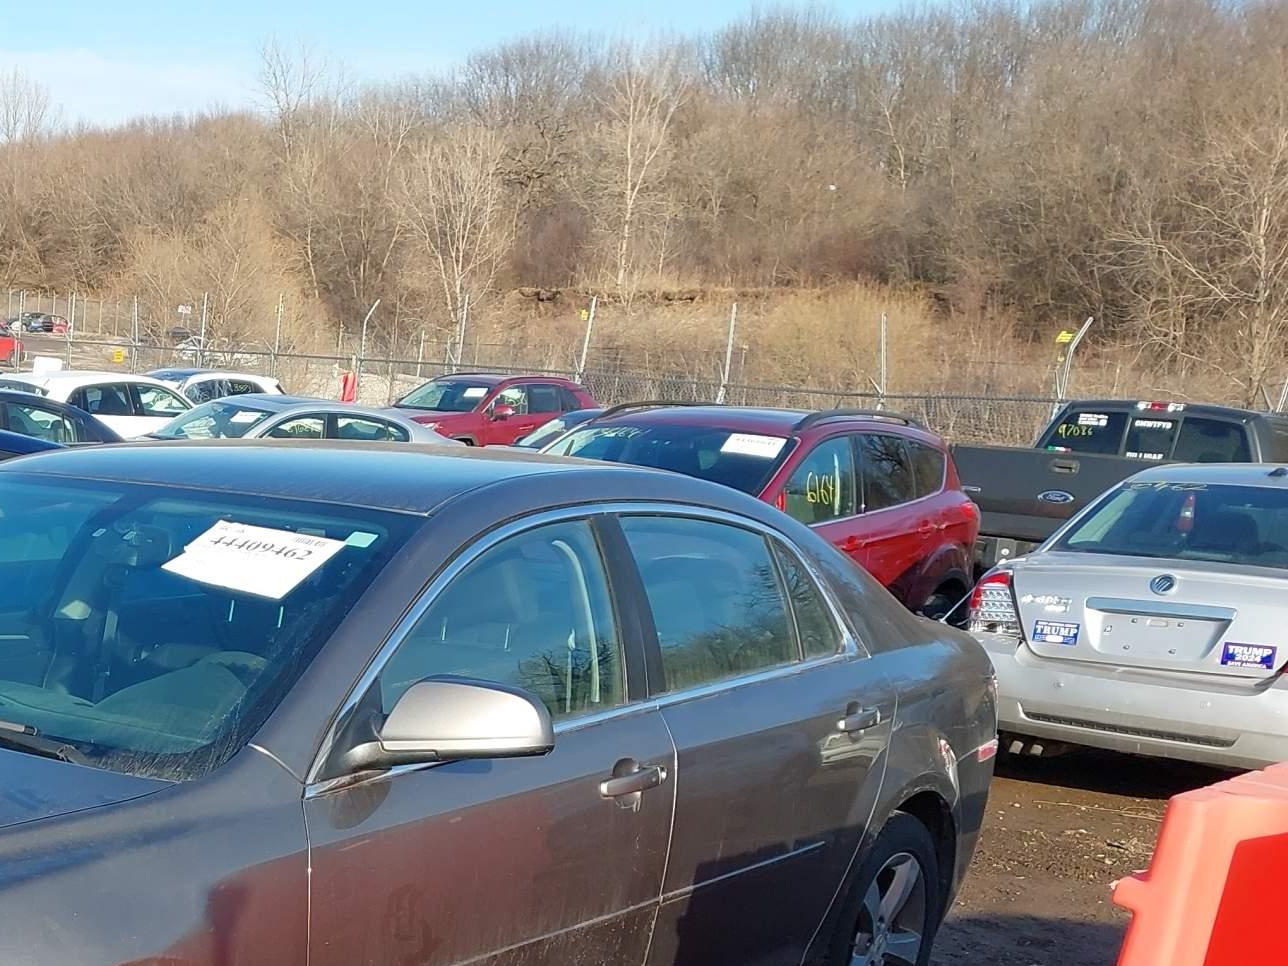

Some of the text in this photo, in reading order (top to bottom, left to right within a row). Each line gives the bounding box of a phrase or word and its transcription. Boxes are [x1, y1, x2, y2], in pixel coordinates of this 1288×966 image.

[210, 535, 312, 561] 44409462
[1035, 625, 1078, 637] TRUMP
[1227, 645, 1273, 656] TRUMP
